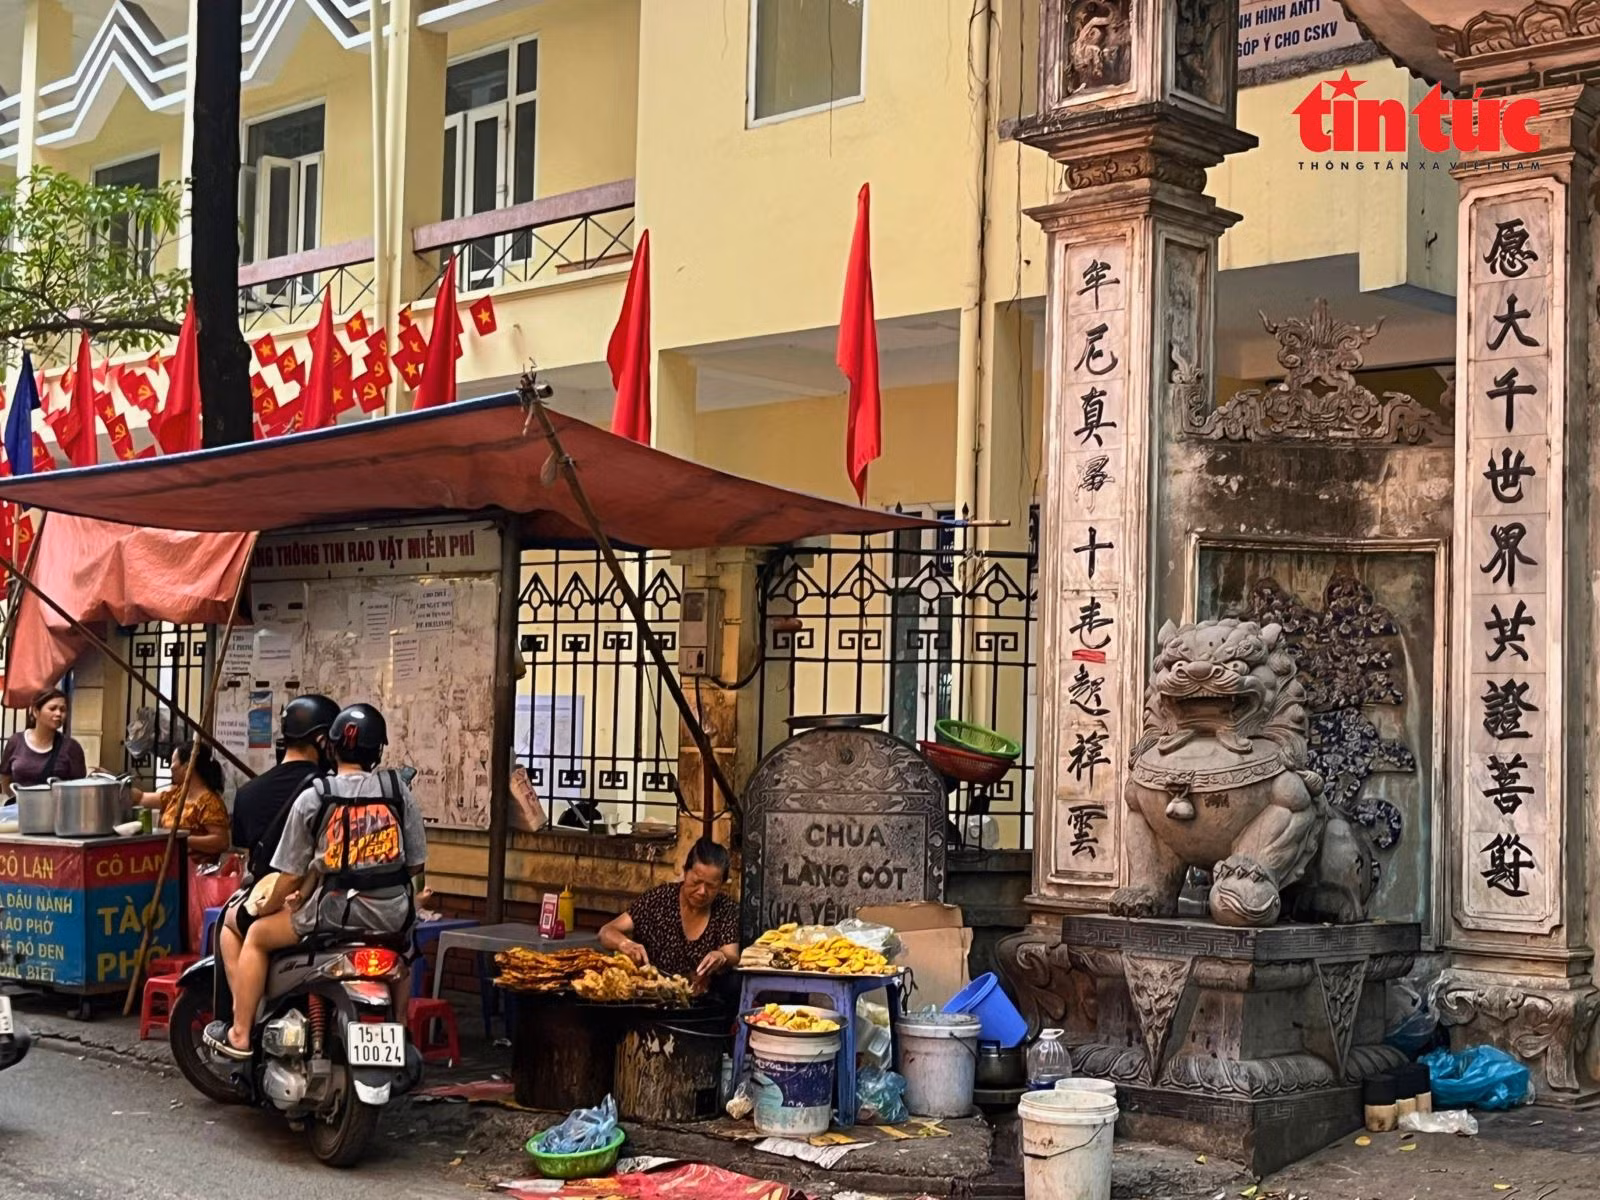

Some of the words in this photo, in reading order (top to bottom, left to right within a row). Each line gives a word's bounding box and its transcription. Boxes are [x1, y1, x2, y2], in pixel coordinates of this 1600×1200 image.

[1255, 5, 1286, 26] HÌNH
[1263, 32, 1271, 52] Ý
[1274, 29, 1300, 49] CHO
[1304, 21, 1338, 42] CSKV
[276, 541, 320, 566] THÔNG
[322, 543, 344, 564] TIN
[348, 540, 375, 562] RAO
[449, 529, 475, 557] PHÍ
[804, 818, 886, 848] CHÙA
[0, 850, 18, 876] CÔ
[23, 856, 53, 879] LAN
[96, 853, 124, 877] CÔ
[782, 854, 849, 888] LÀNG
[36, 890, 73, 914] NÀNH
[96, 895, 166, 936] TÀO
[26, 915, 54, 935] PHỚ
[38, 943, 64, 960] ĐEN
